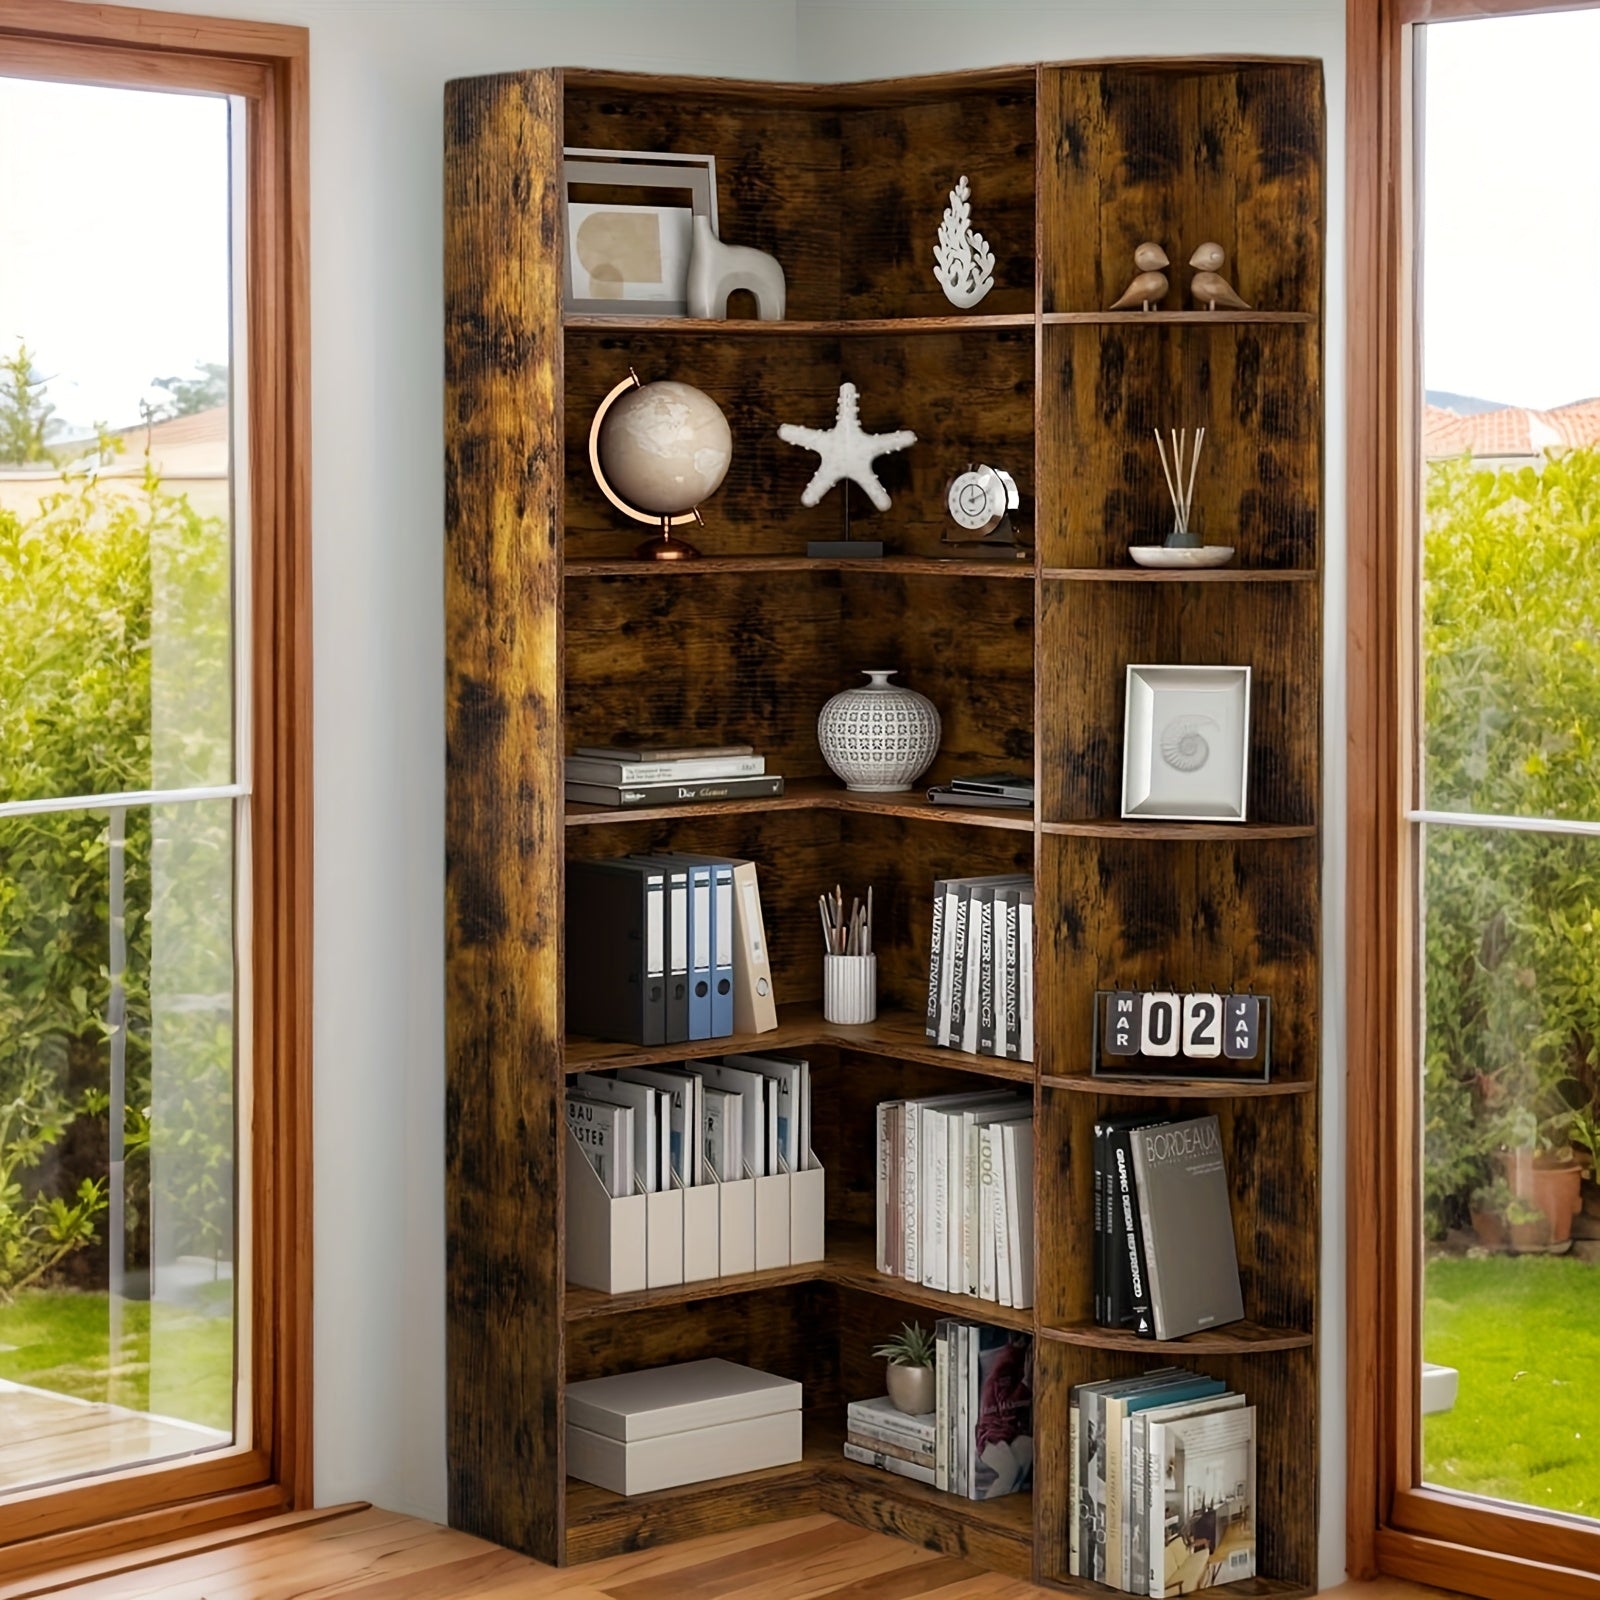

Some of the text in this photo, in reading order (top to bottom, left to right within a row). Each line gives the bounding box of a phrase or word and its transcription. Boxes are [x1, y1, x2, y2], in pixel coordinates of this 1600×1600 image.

[981, 964, 991, 1028] FINANCE
[1116, 999, 1133, 1046] MAR
[1235, 1003, 1249, 1049] JAN
[569, 1103, 593, 1122] BAU
[1146, 1122, 1219, 1163] BORDEAUX
[1116, 1148, 1129, 1193] GRAPHIC
[1122, 1194, 1134, 1231] DESIGN
